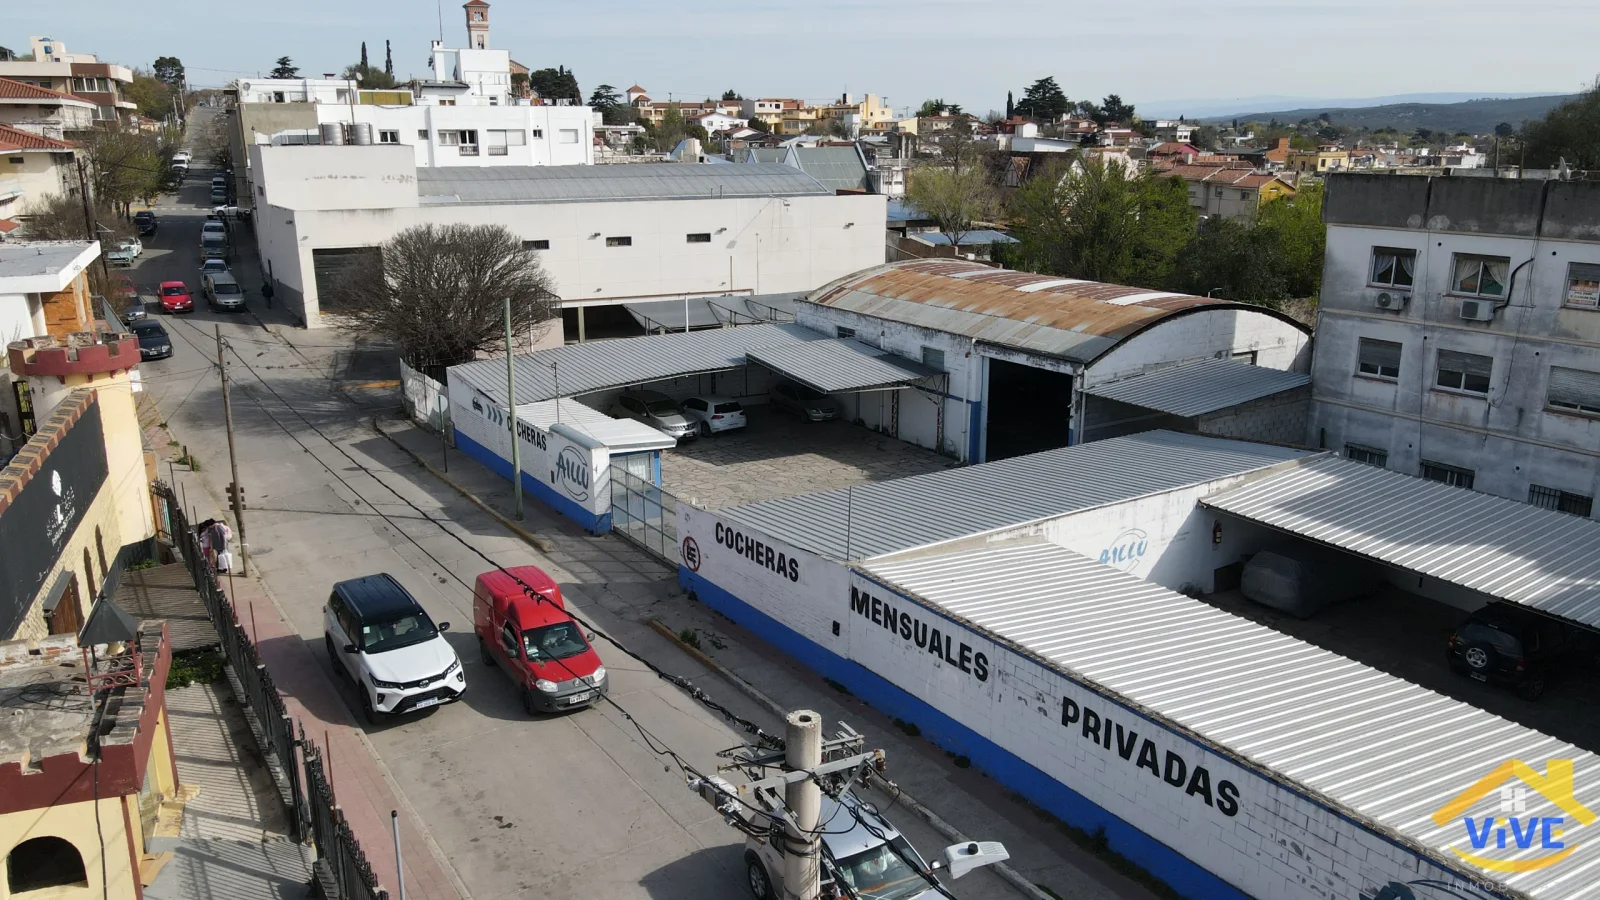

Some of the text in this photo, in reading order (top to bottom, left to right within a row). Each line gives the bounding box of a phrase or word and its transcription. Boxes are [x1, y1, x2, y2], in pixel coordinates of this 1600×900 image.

[507, 416, 547, 451] CCHERAS
[715, 521, 1240, 817] COCHERAS MENSUALES PRIVADAS
